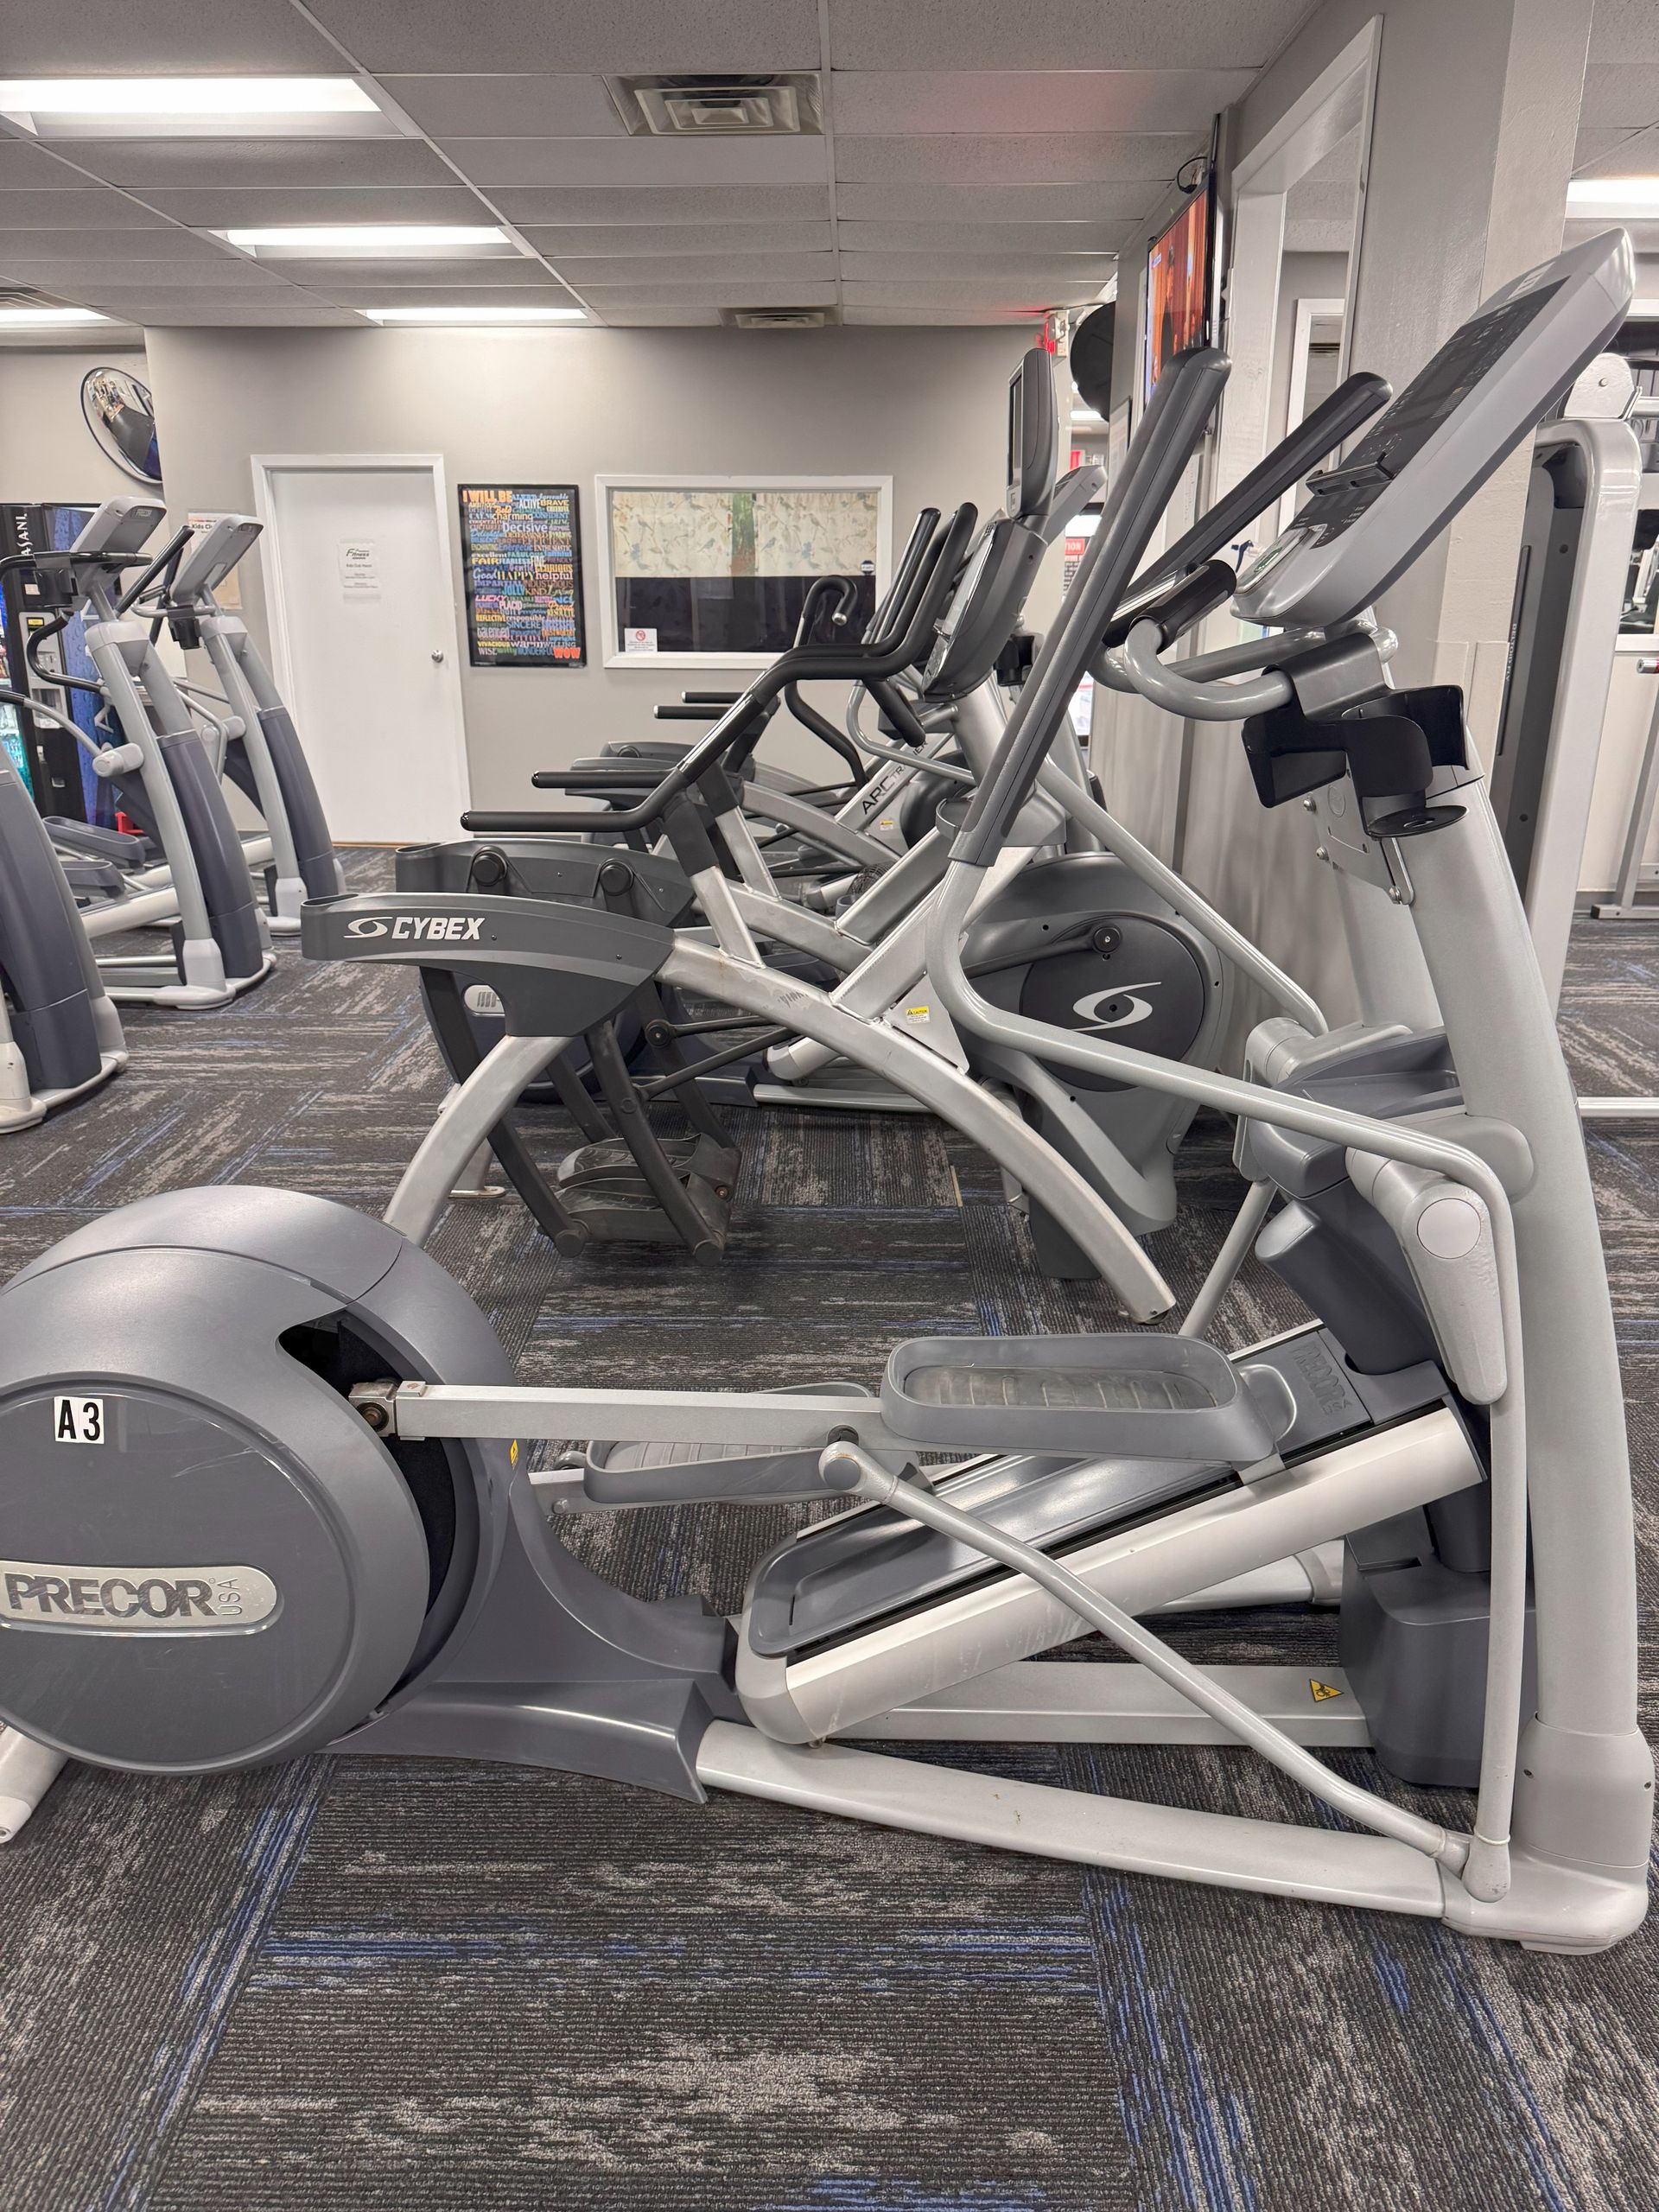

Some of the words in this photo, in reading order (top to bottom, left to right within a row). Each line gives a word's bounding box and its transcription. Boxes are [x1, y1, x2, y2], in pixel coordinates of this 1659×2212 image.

[462, 490, 467, 502] I
[468, 490, 497, 502] WILL
[498, 490, 512, 502] BE
[518, 499, 540, 508] ACTIVE
[492, 513, 533, 522] charming
[503, 522, 548, 532] Decisive
[473, 568, 498, 581] Good
[497, 571, 534, 580] HAPPY
[536, 571, 573, 582] helpful
[501, 584, 525, 595] JOLLY
[499, 601, 522, 610] PLACID
[478, 647, 499, 656] WISE
[553, 647, 581, 658] WOW
[862, 776, 895, 815] ARC
[391, 917, 486, 940] CYBEX
[4, 1572, 218, 1618] PRECOR
[218, 1577, 242, 1616] USA
